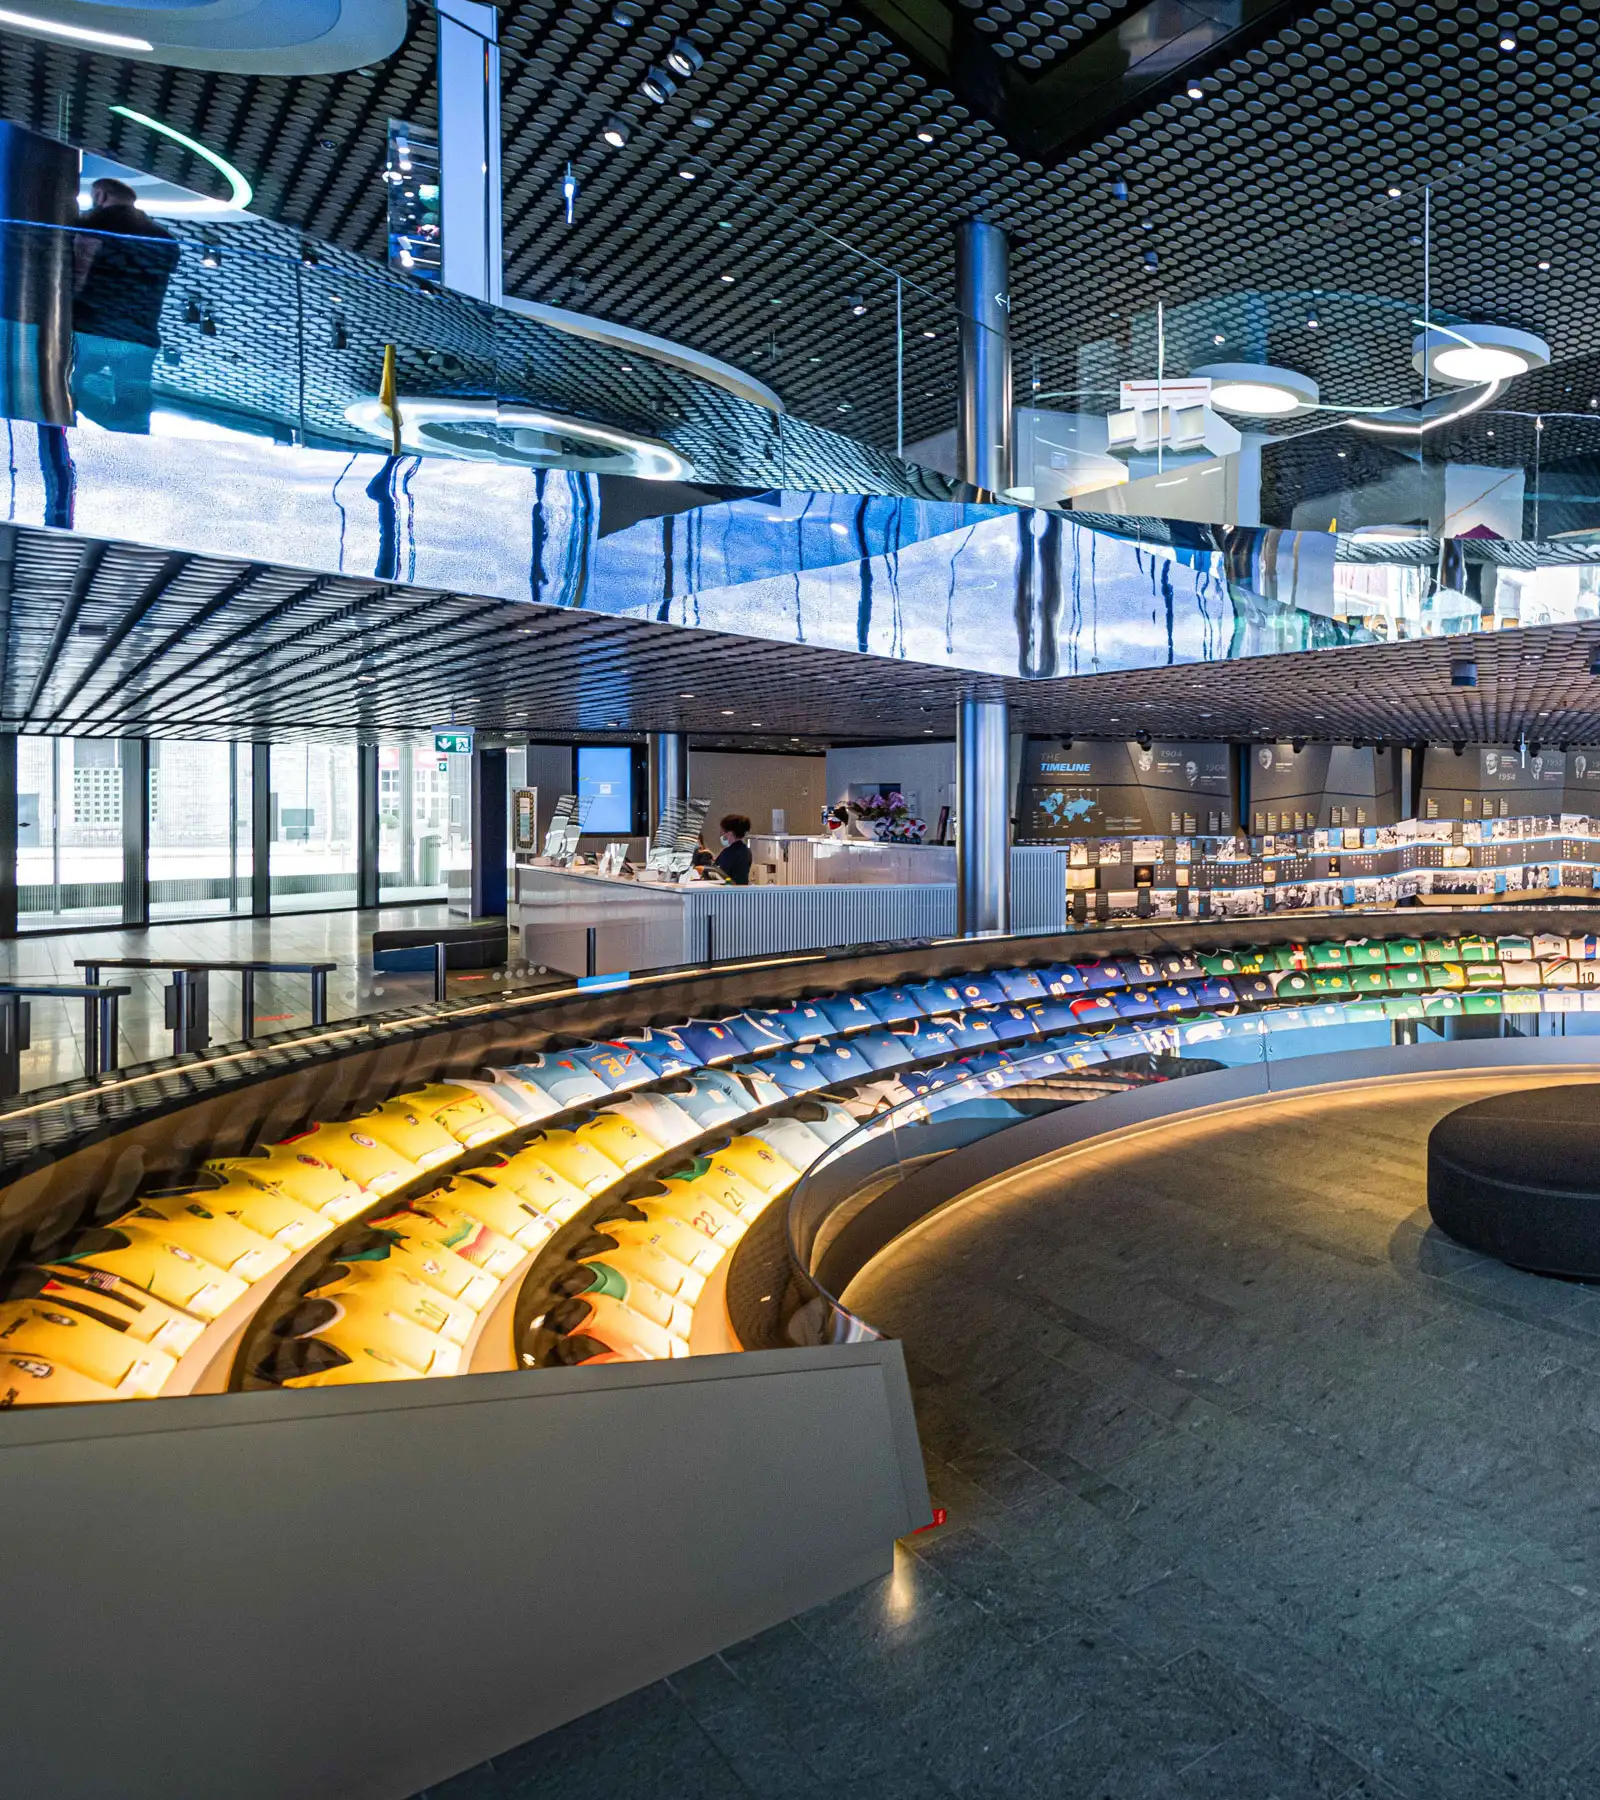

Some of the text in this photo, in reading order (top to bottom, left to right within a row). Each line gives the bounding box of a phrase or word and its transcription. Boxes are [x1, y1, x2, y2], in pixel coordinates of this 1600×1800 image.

[1040, 753, 1060, 762] THE
[1040, 762, 1091, 772] TIMELINE
[1581, 971, 1594, 984] 10
